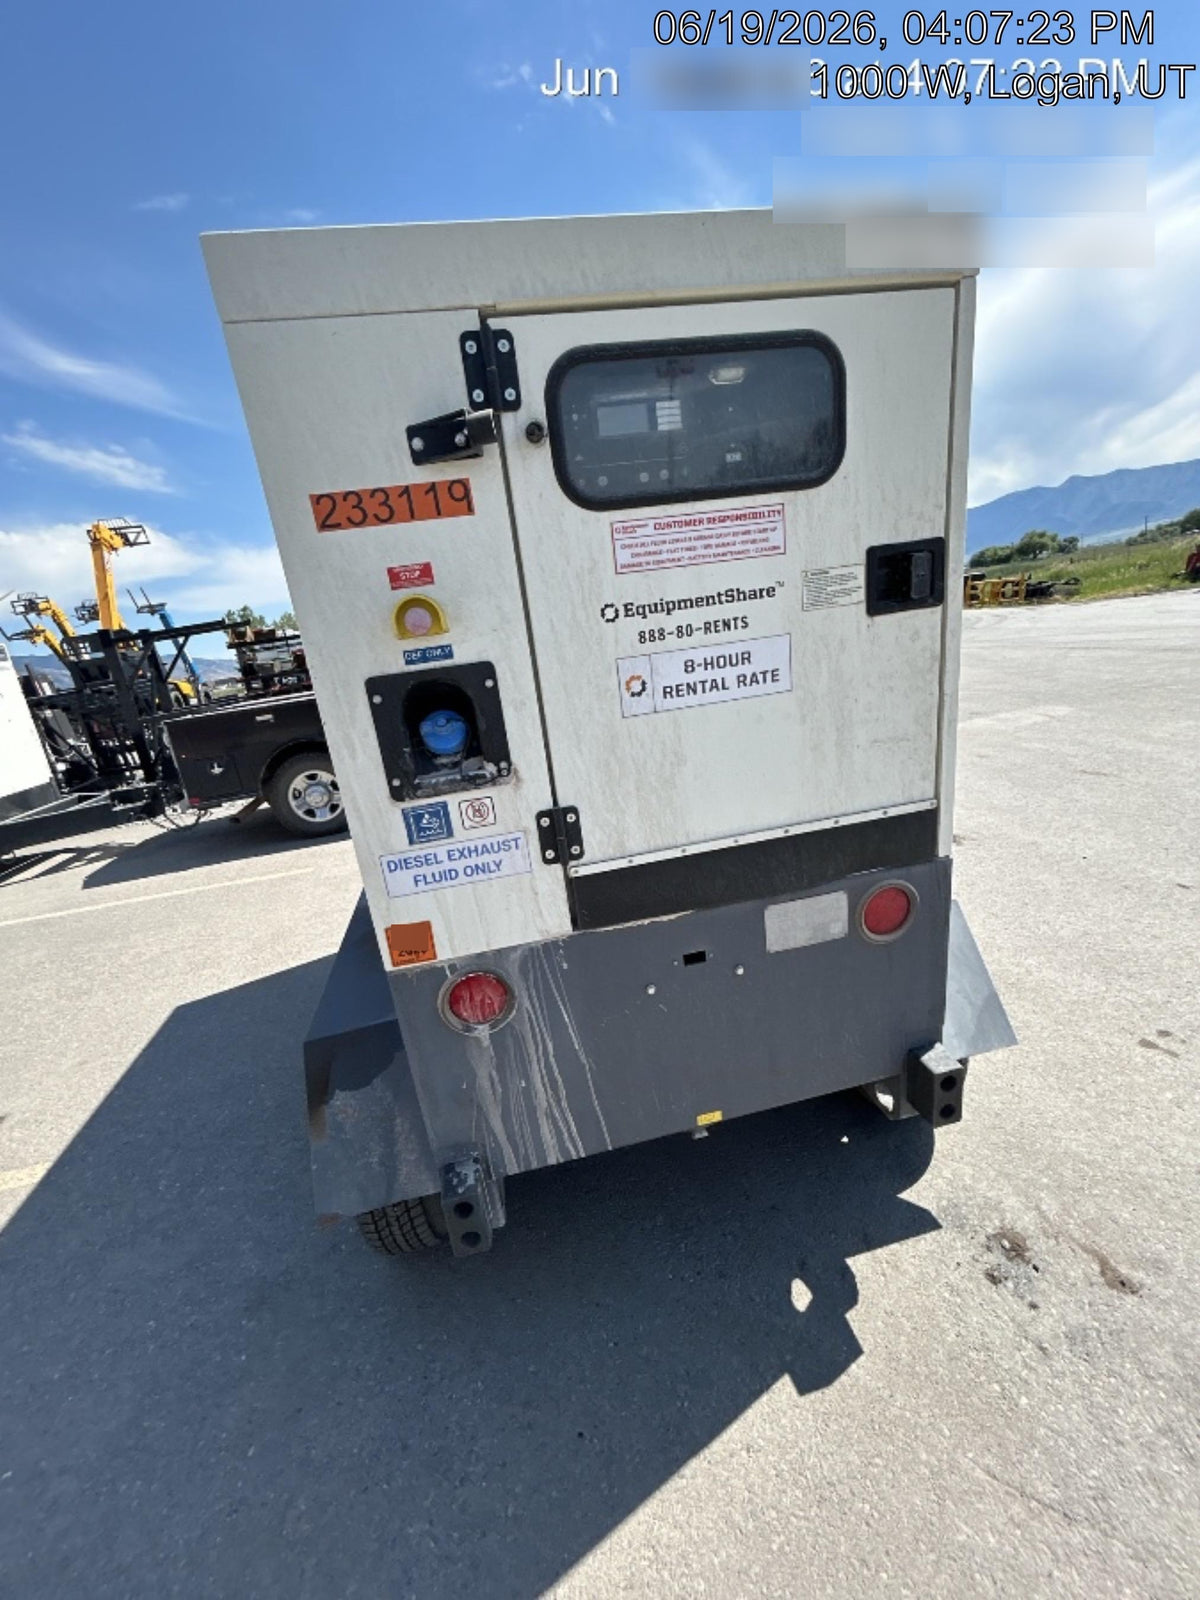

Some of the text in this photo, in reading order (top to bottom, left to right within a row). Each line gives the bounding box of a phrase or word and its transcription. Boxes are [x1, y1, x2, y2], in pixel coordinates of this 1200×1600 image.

[314, 479, 475, 530] 233119
[653, 515, 705, 531] CUSTOMER
[706, 509, 782, 525] RESPONSIBILITY
[637, 615, 750, 645] 888-80-RENTS
[683, 650, 752, 674] 8-HOUR
[662, 668, 780, 700] RENTAL RATE
[386, 837, 522, 874] DIESEL EXHAUST
[413, 859, 503, 888] FLUID ONLY
